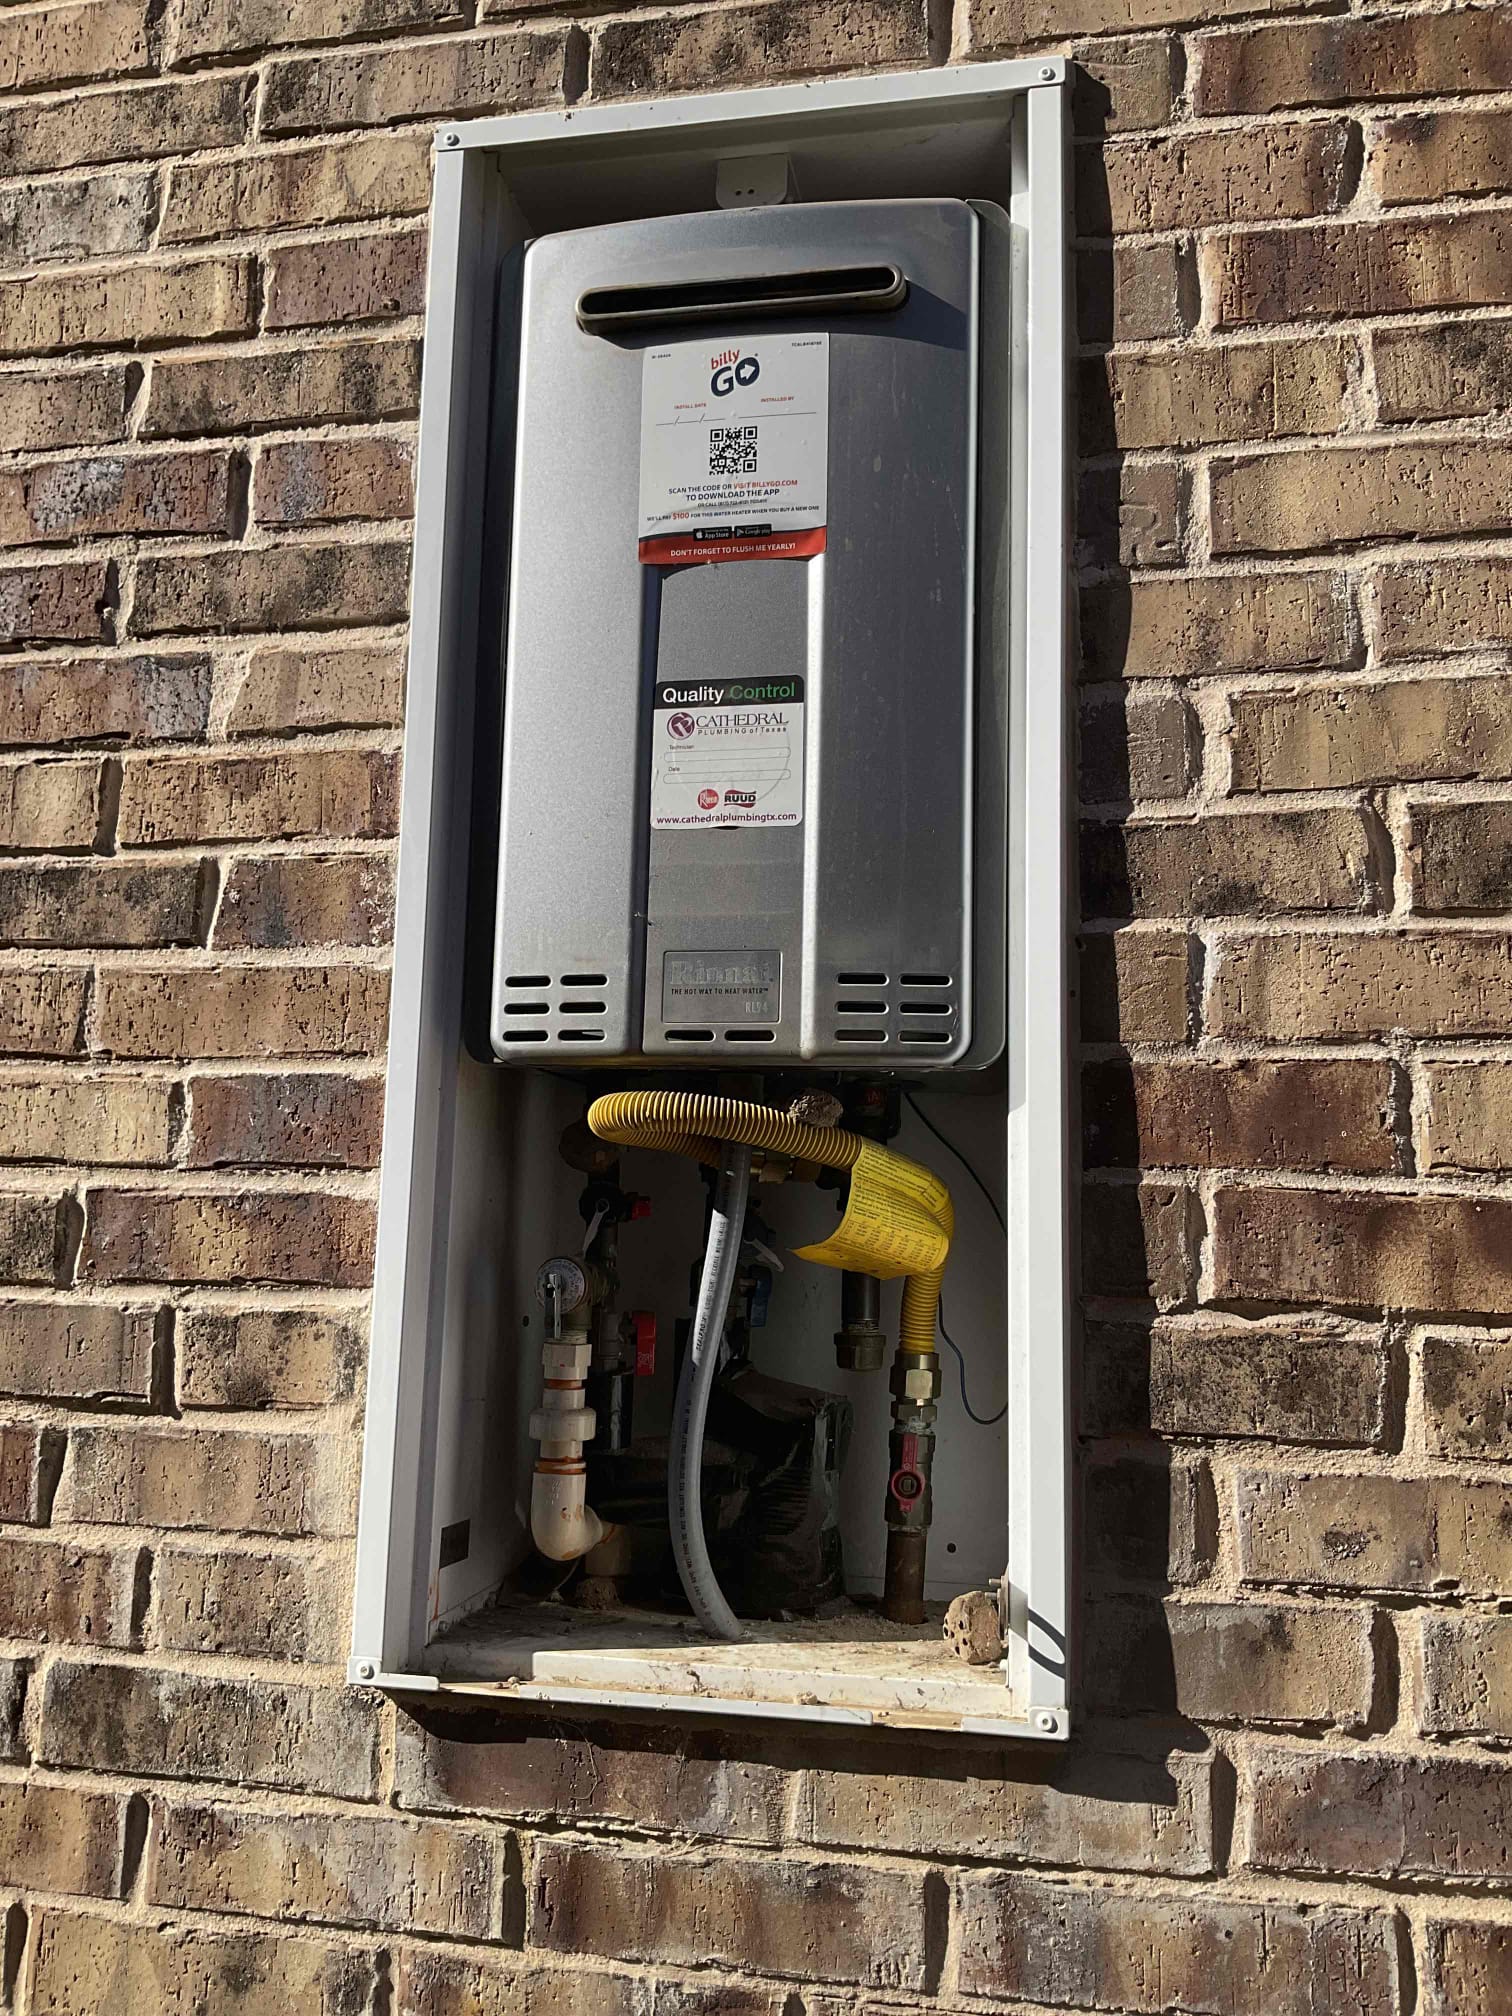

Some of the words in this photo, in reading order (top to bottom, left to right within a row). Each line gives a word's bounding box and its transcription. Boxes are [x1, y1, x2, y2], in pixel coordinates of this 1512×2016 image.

[711, 349, 740, 370] billy
[711, 356, 760, 397] GO
[751, 480, 798, 488] BILLYGO.COM
[686, 494, 697, 502] TO
[698, 490, 745, 500] DOWNLOAD
[746, 489, 763, 497] THE
[764, 488, 780, 496] APP
[672, 512, 690, 520] $100
[693, 547, 721, 555] FORGET
[662, 686, 724, 704] Quality
[729, 682, 795, 699] Control
[696, 712, 789, 728] CATHEDRAL
[697, 727, 746, 735] PLUMBING
[724, 794, 757, 803] RUUD
[656, 812, 797, 824] www.cathedralplumbingtx.com
[670, 960, 769, 985] Rinnai
